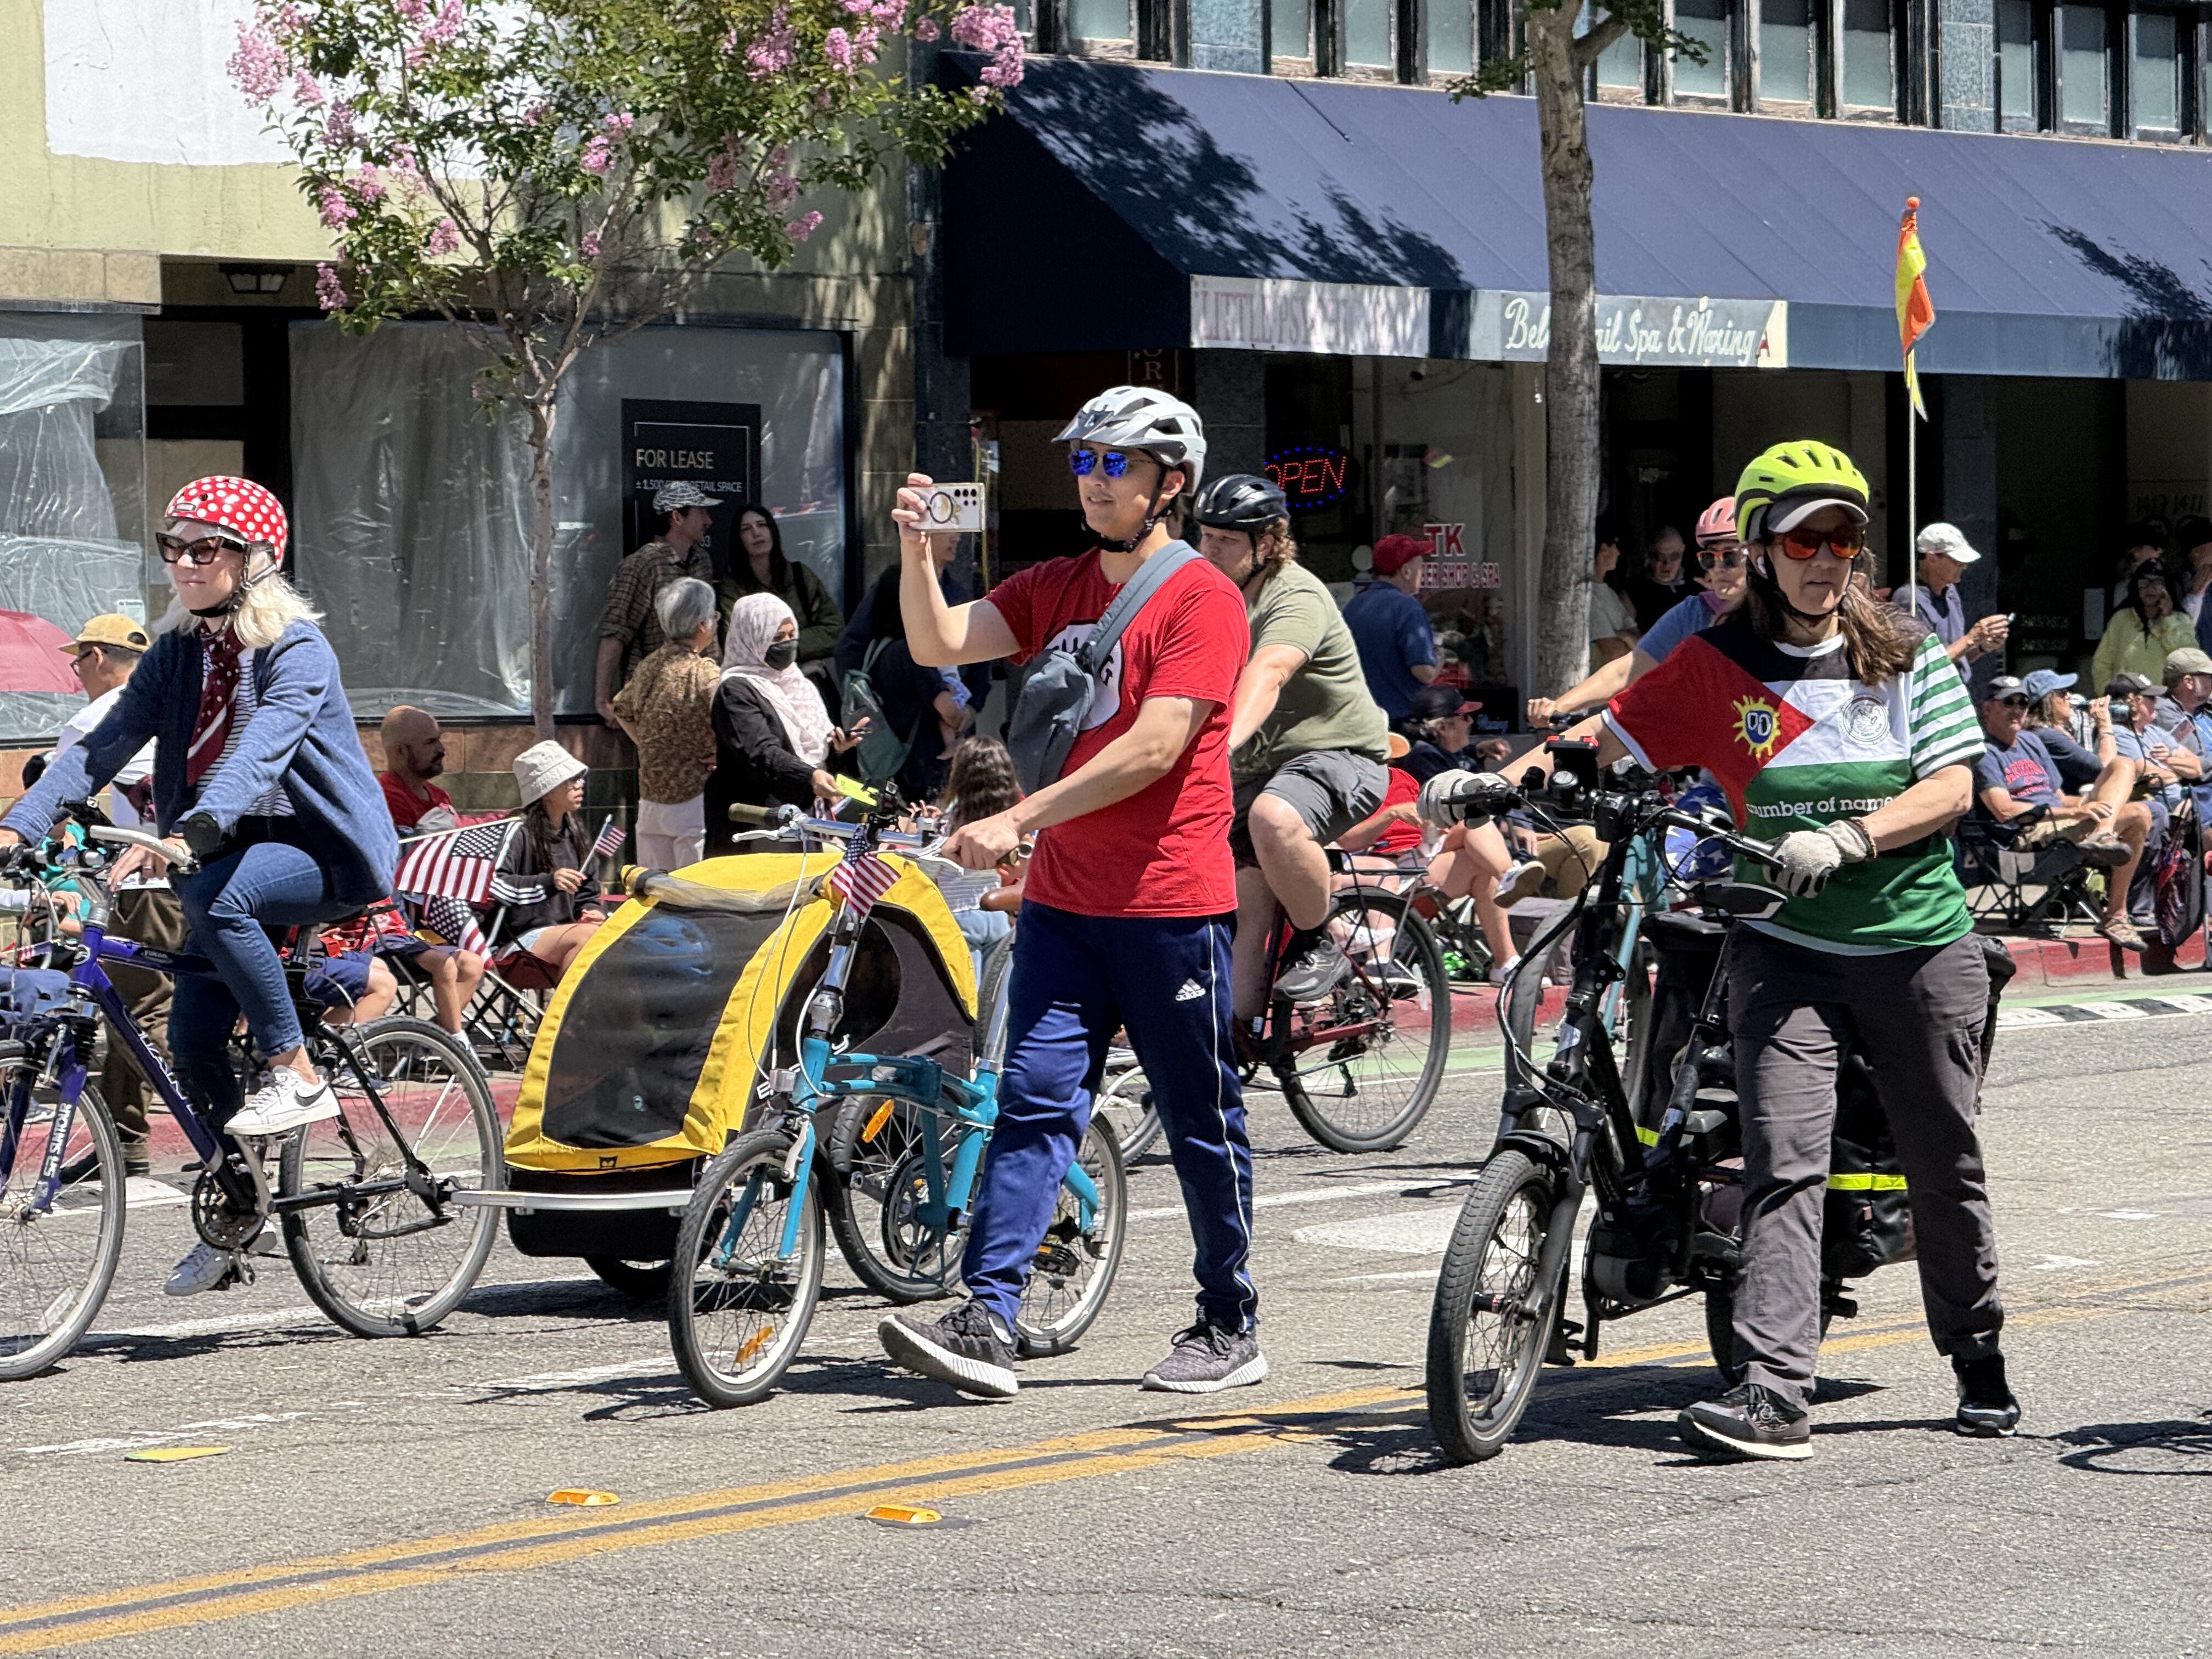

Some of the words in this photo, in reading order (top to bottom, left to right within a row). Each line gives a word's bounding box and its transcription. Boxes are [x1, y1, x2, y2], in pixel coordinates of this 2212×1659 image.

[1504, 297, 1551, 349] Bel
[1594, 303, 1623, 353] ail
[1624, 308, 1664, 362] Spa
[1667, 304, 1686, 354] &
[1686, 308, 1757, 367] Waxing
[635, 449, 667, 468] FOR
[670, 450, 715, 469] LEASE
[1264, 455, 1347, 494] OPEN
[717, 482, 743, 492] SPACE
[1423, 523, 1466, 557] TK
[1420, 562, 1440, 589] BER
[1441, 562, 1469, 589] SHOP
[1470, 562, 1480, 589] &
[1480, 562, 1501, 589] SPA
[1816, 796, 1837, 814] of
[1839, 795, 1896, 811] name
[1175, 988, 1207, 1001] adidas
